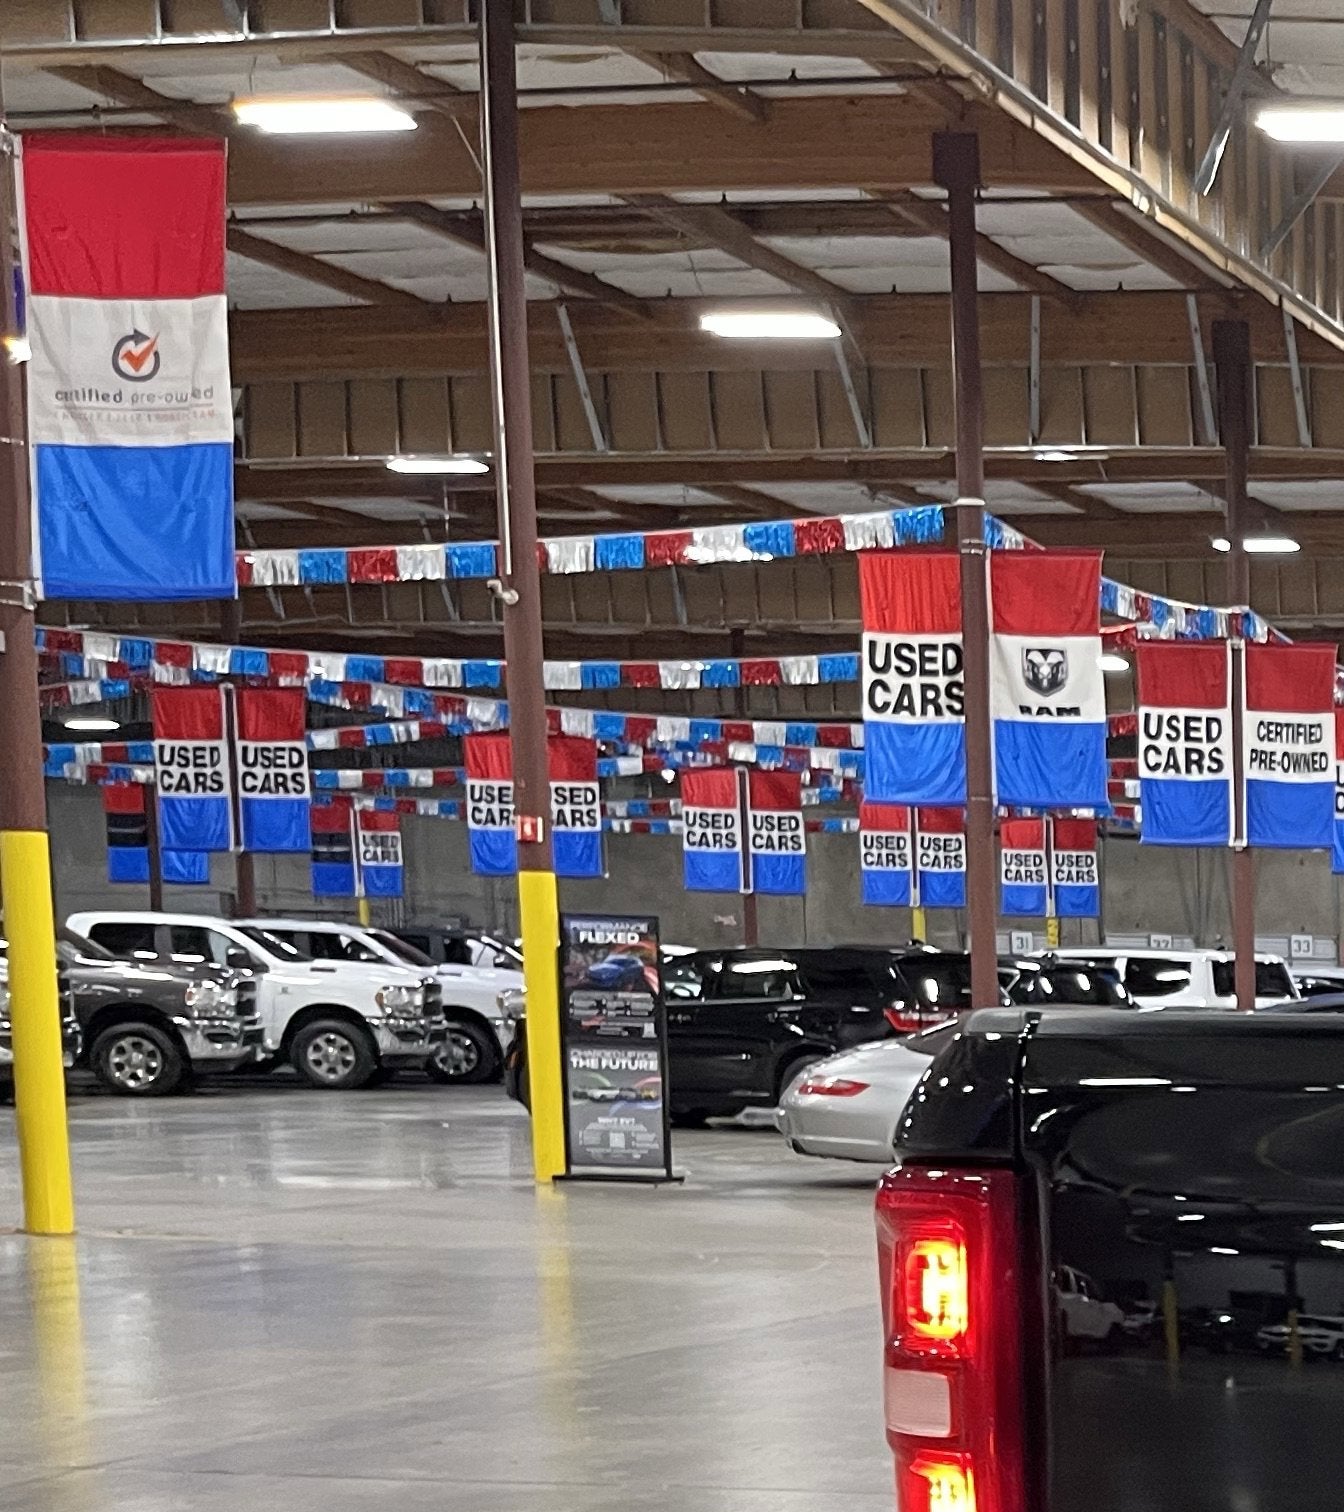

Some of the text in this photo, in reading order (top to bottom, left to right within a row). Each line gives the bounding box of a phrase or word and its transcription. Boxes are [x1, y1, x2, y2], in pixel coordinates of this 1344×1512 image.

[868, 640, 964, 678] USED
[868, 678, 964, 717] CARS
[1143, 712, 1222, 743] USED
[1256, 720, 1323, 745] CERTIFIED
[158, 744, 221, 769] USED
[241, 745, 305, 769] USED
[1143, 744, 1225, 775] CARS
[1249, 748, 1329, 774] PRE-OWNED
[159, 769, 224, 794] CARS
[241, 771, 306, 794] CARS
[469, 784, 512, 805] USE
[554, 786, 597, 806] SED
[470, 806, 514, 826] CAR
[556, 808, 598, 828] ARS
[685, 810, 735, 830] USED
[752, 814, 801, 832] USED
[686, 830, 737, 849] CARS
[751, 833, 802, 851] CARS
[863, 834, 907, 851] USED
[919, 835, 963, 852] USED
[863, 851, 908, 868] CARS
[919, 853, 964, 869] CARS
[1004, 852, 1043, 867] USED
[1055, 853, 1095, 868] USED
[1004, 868, 1045, 883] CARS
[1055, 869, 1096, 883] CARS
